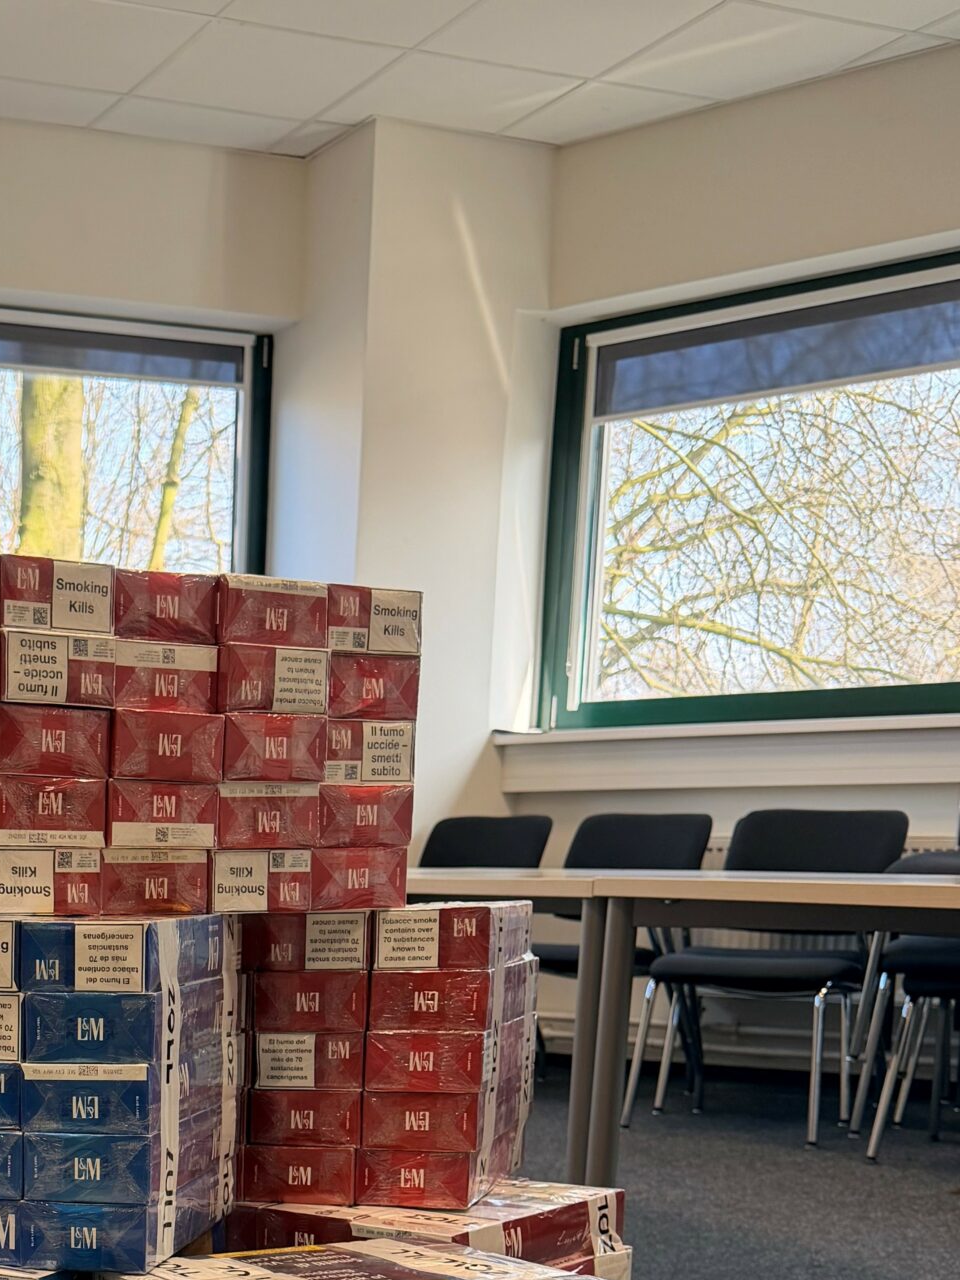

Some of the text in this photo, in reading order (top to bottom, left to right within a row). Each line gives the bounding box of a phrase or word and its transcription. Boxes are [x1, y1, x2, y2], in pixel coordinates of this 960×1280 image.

[56, 578, 109, 597] Smoking
[69, 600, 94, 614] Kills
[374, 604, 418, 620] Smoking
[384, 625, 405, 637] Kills
[77, 1018, 104, 1041] L&M
[167, 984, 175, 1084] ZOLL
[401, 1168, 424, 1188] L&M
